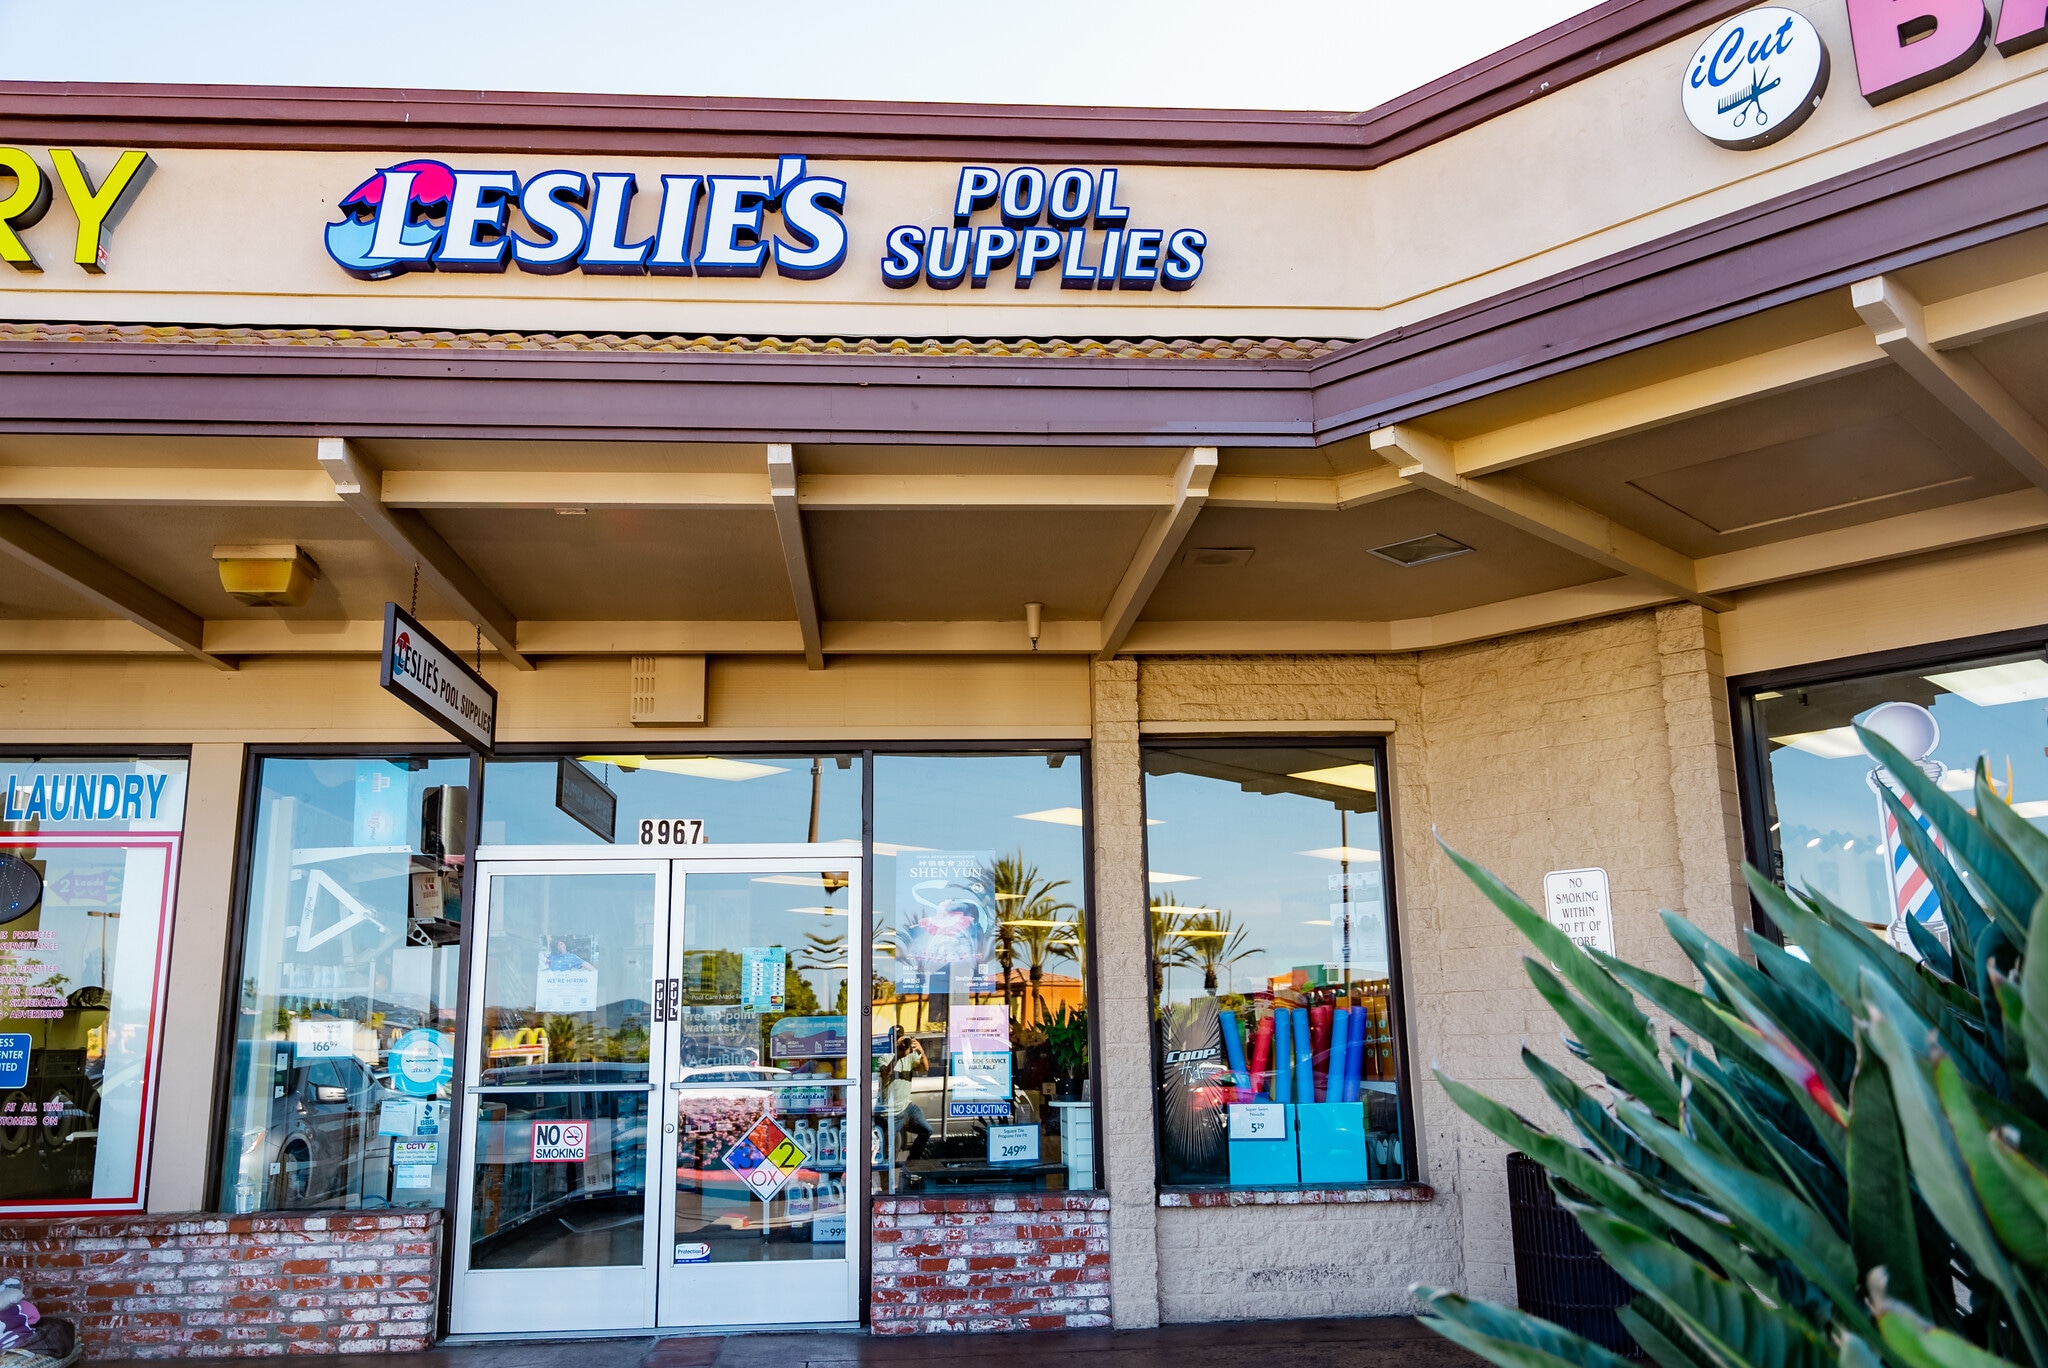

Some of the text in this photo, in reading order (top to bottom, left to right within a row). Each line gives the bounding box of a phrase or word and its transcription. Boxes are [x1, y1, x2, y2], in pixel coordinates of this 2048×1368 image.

[1690, 16, 1795, 89] iCut
[954, 165, 1130, 230] POOL
[367, 154, 850, 282] LESLIE'S
[880, 225, 1208, 291] SUPPLIES
[396, 636, 493, 735] LESLIE'S POOL SUPPLIES
[4, 774, 168, 822] LAUNDRY
[640, 819, 703, 845] 8967
[909, 867, 983, 878] SHEN YUN
[1568, 877, 1583, 889] NO
[1555, 890, 1599, 904] SMOKING
[1561, 906, 1596, 918] WITHIN
[1559, 921, 1601, 933] 20 FT OF
[13, 931, 57, 940] PROTECTED
[0, 942, 58, 950] SURVEILLANCE
[16, 965, 59, 974] PERMITTED
[655, 982, 664, 1019] PULL
[669, 981, 678, 1018] PULL
[691, 993, 704, 1001] Pool
[10, 999, 68, 1008] SKATEBOARDS
[10, 1010, 64, 1019] ADVERTISING
[684, 1012, 707, 1021] Free
[684, 1023, 741, 1033] water test
[689, 1053, 752, 1068] AccuBlue
[4, 1102, 64, 1112] AT ALL TIME
[952, 1104, 1008, 1114] NO SOLICITING
[42, 1116, 59, 1126] ON
[536, 1125, 561, 1146] NO
[535, 1148, 585, 1159] SMOKING
[738, 1143, 755, 1170] 3
[779, 1142, 796, 1168] 2
[752, 1170, 778, 1187] OX
